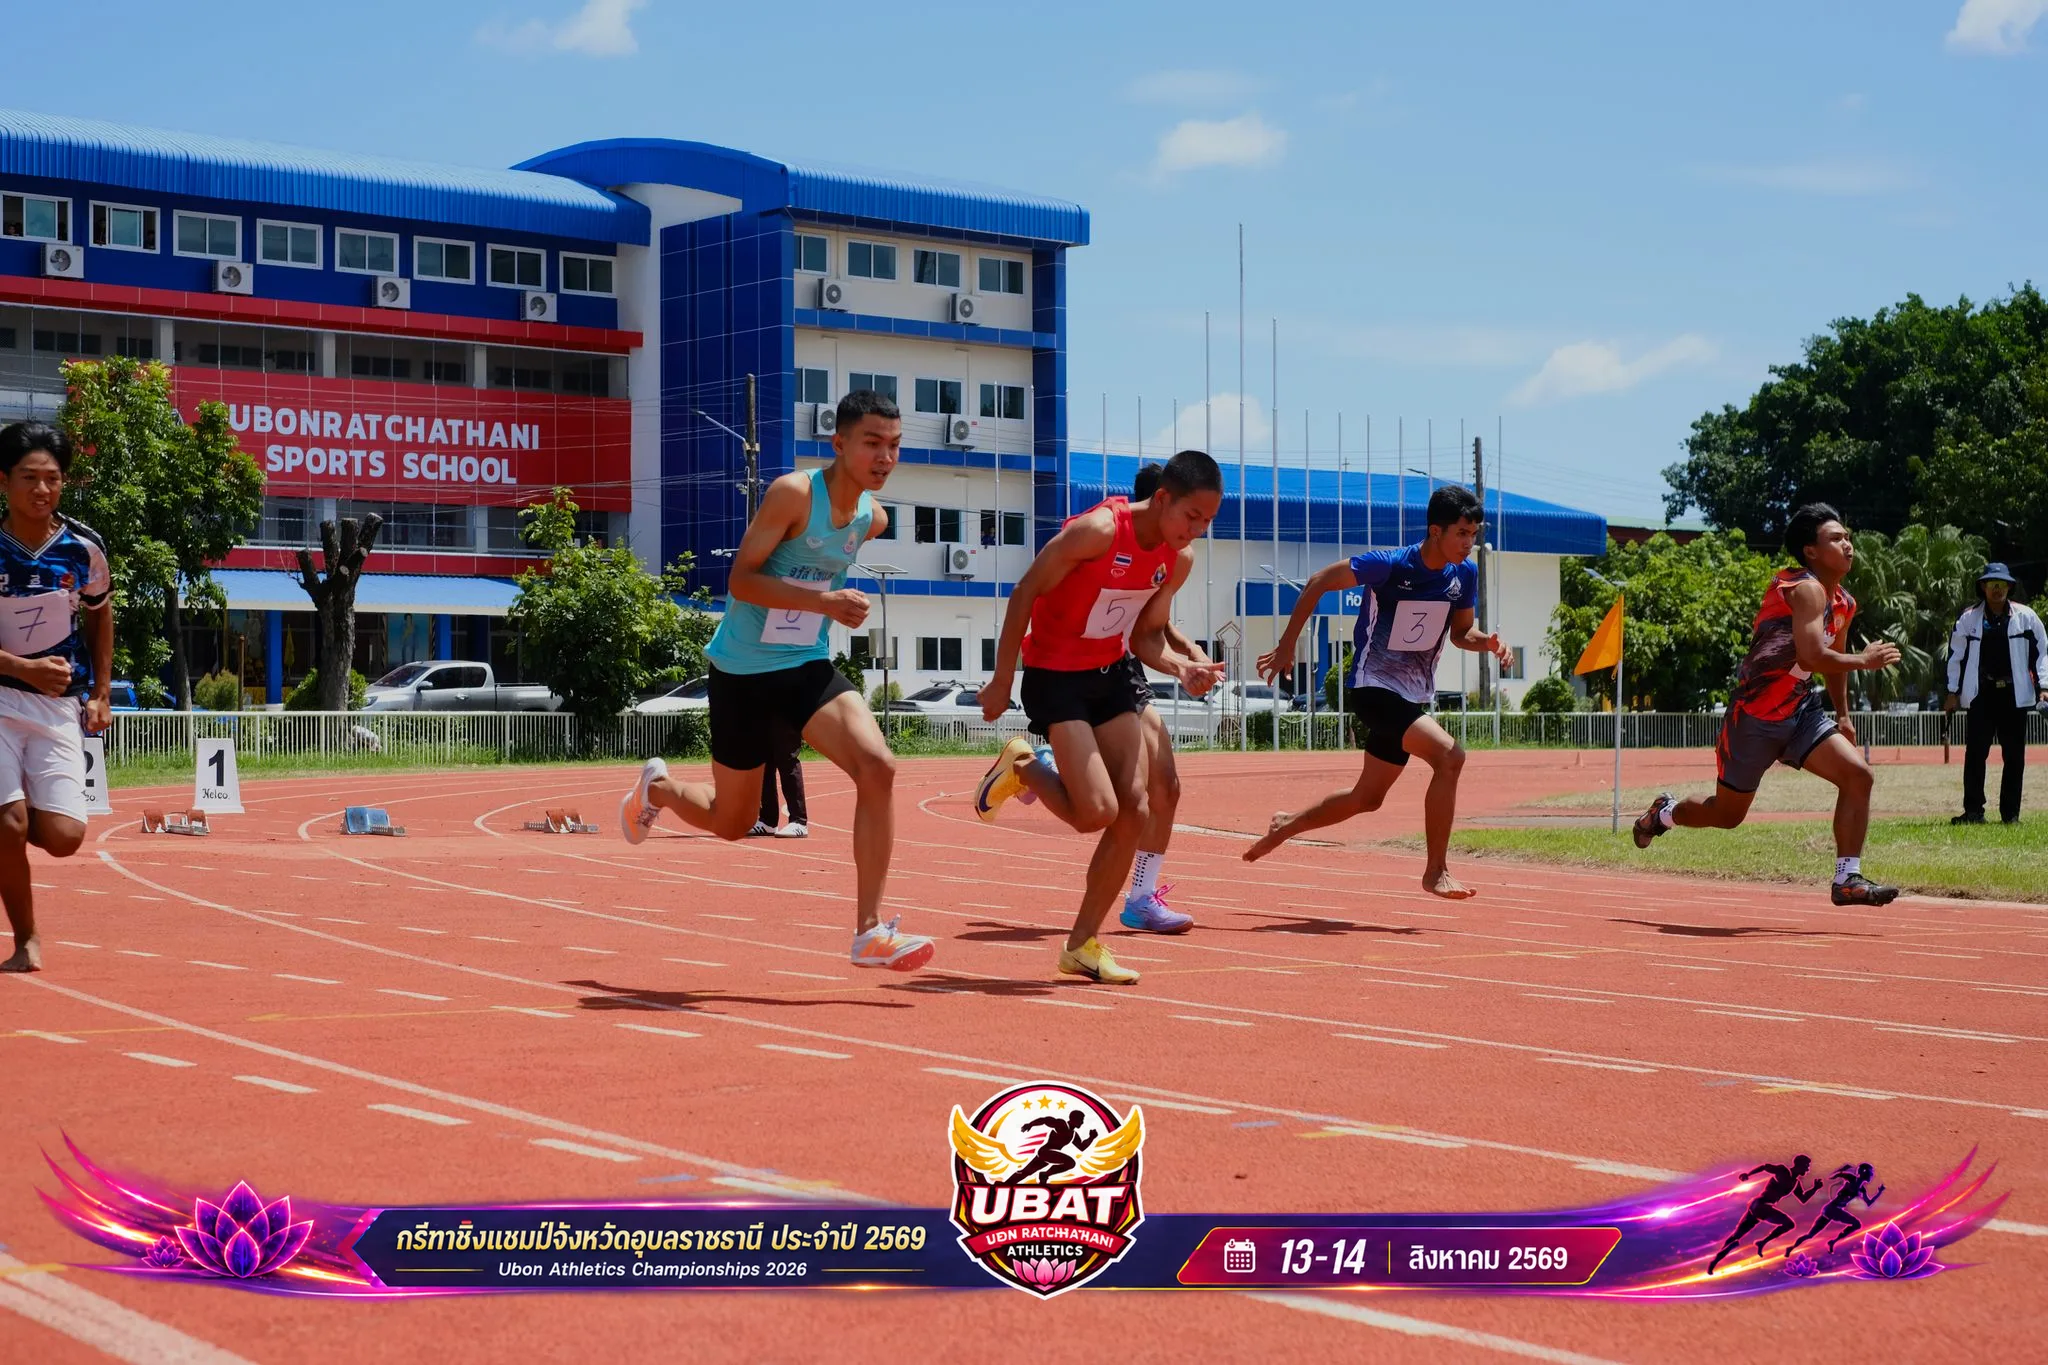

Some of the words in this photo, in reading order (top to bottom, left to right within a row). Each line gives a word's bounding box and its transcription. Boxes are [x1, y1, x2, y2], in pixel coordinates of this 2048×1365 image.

[229, 402, 540, 450] UBONRATCHATHANI
[266, 444, 386, 478] SPORTS
[402, 452, 517, 485] SCHOOL
[14, 606, 47, 642] 7
[1102, 596, 1133, 632] 5
[1402, 612, 1428, 644] 3
[208, 749, 225, 787] 1
